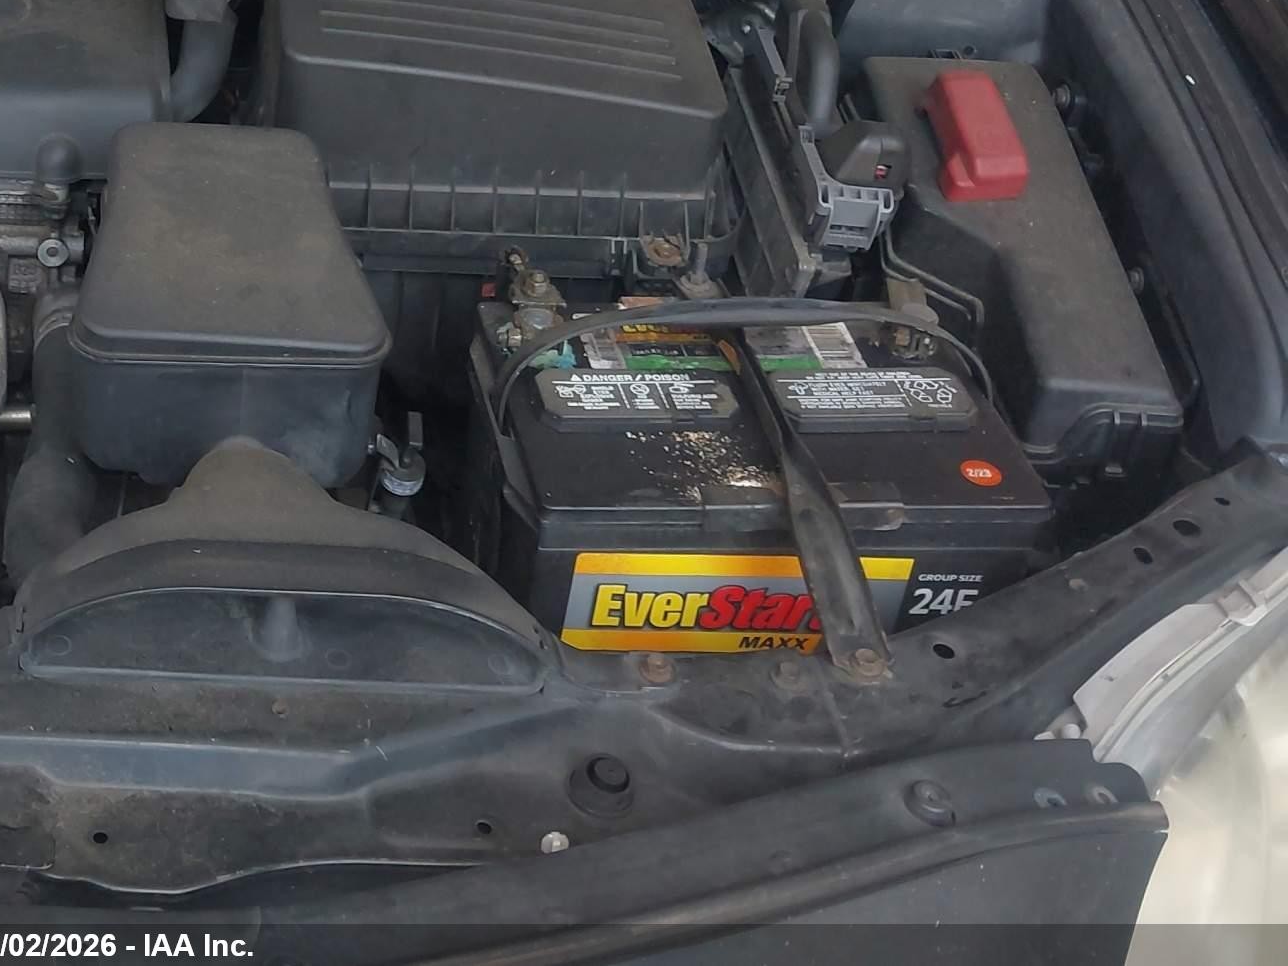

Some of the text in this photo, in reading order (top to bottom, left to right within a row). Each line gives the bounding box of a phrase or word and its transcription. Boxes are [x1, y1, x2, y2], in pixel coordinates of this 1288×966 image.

[582, 374, 633, 382] DANGER
[644, 373, 691, 381] POISON
[917, 573, 984, 582] GROUP SIZE
[592, 583, 821, 630] EverStar
[738, 636, 809, 650] MAXX
